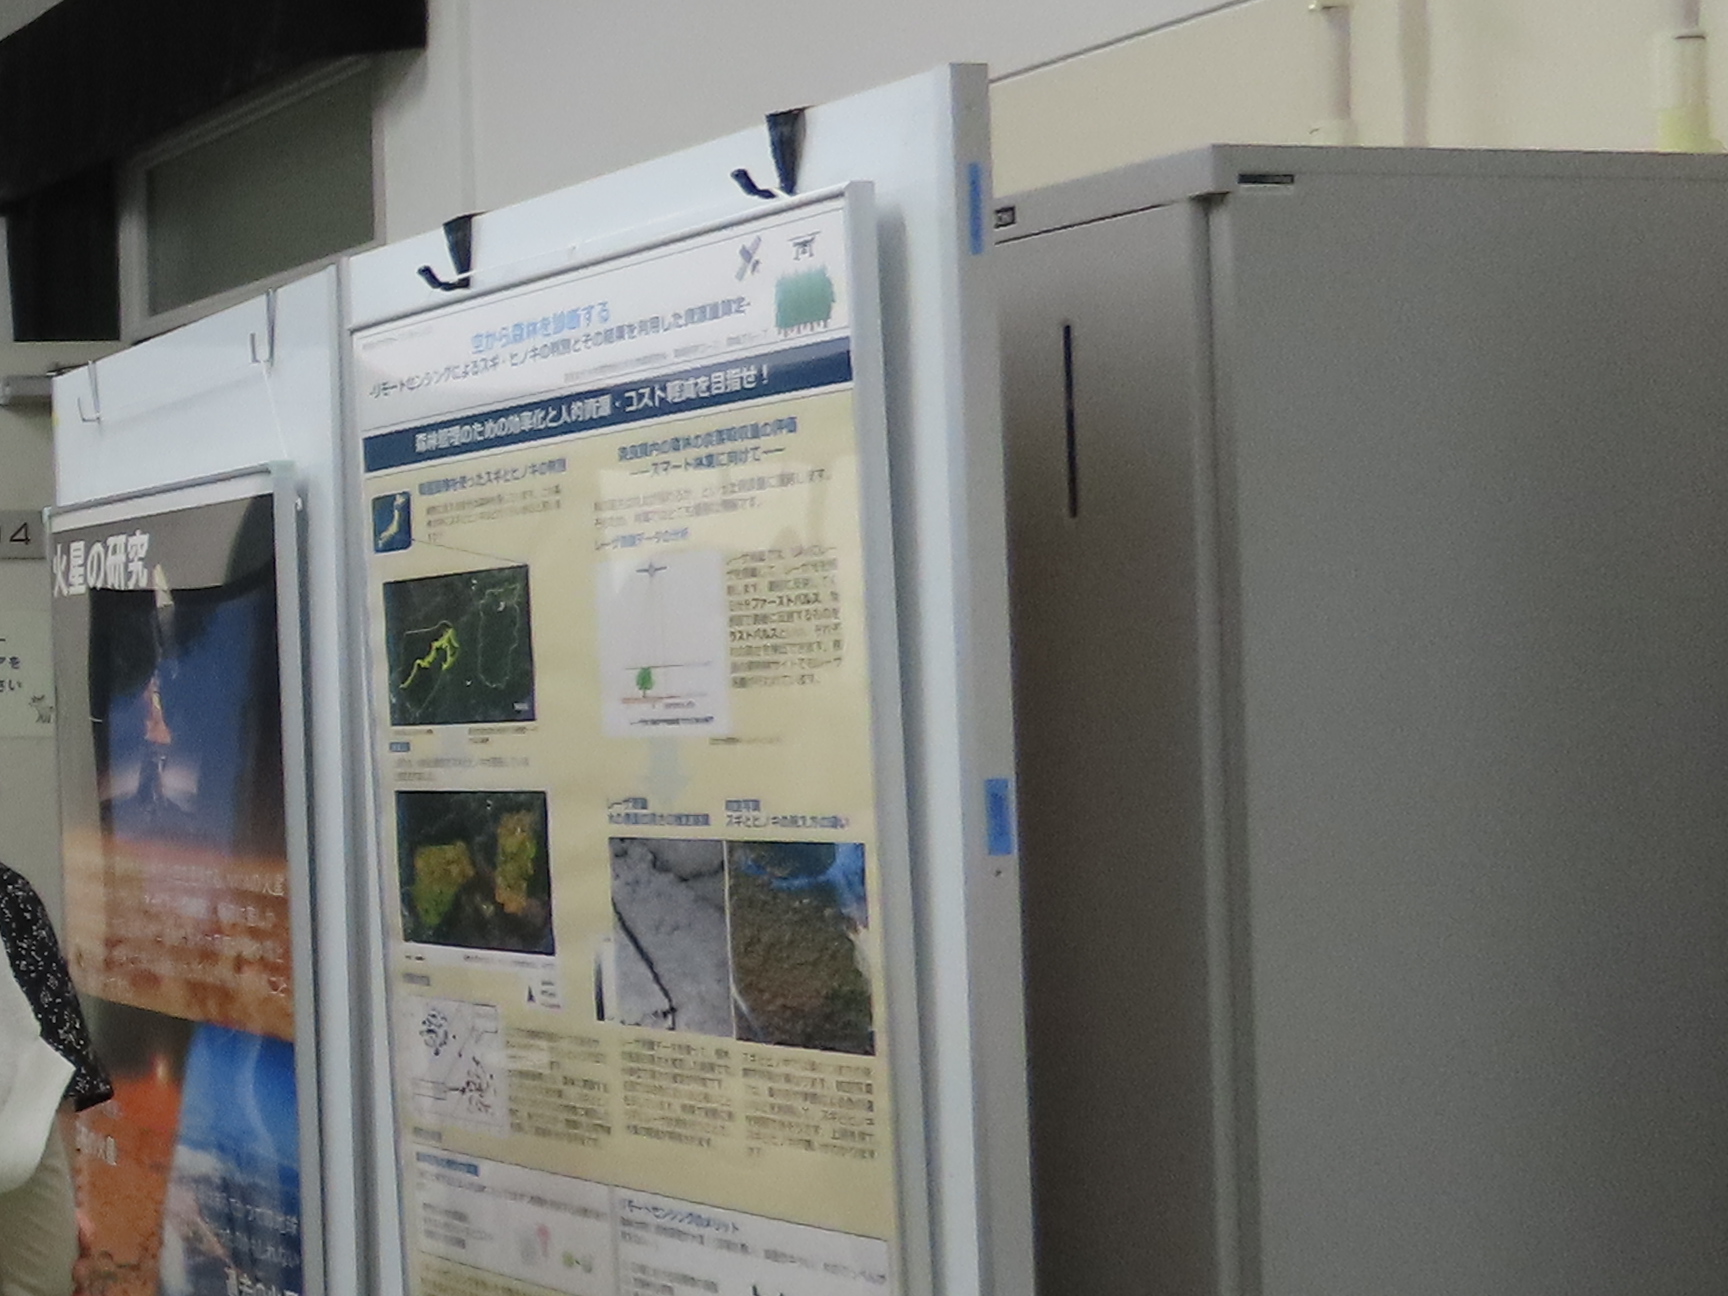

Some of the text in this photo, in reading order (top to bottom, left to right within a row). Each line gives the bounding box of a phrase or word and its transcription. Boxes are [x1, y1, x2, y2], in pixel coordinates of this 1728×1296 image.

[52, 530, 149, 598] 火星の研究
